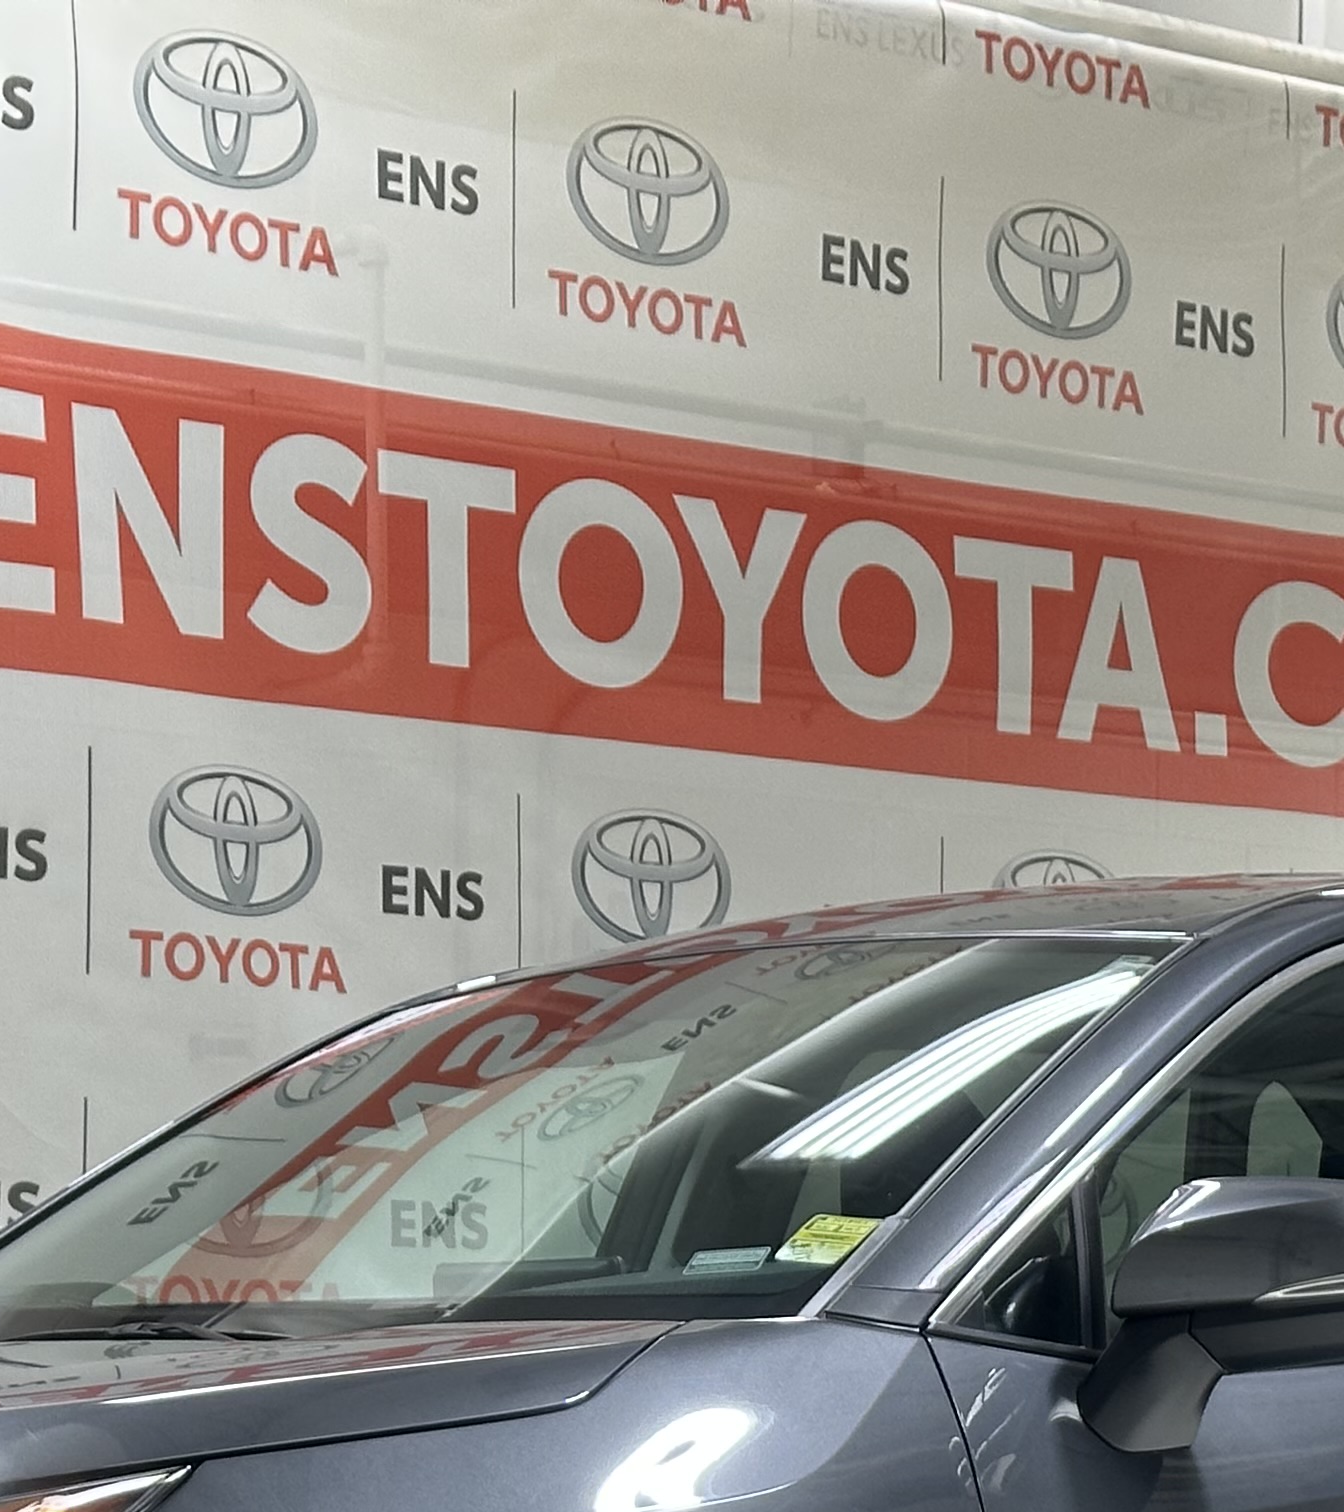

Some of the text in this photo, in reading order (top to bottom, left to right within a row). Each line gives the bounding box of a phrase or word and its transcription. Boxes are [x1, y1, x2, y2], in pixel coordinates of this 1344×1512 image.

[974, 28, 1150, 108] TOYOTA
[377, 149, 480, 216] ENS
[117, 188, 339, 277] TOYOTA
[821, 233, 910, 295] ENS
[548, 269, 747, 348] TOYOTA
[1174, 300, 1256, 358] ENS
[971, 343, 1144, 415] TOYOTA
[381, 864, 485, 921] ENS
[129, 929, 347, 994] TOYOTA
